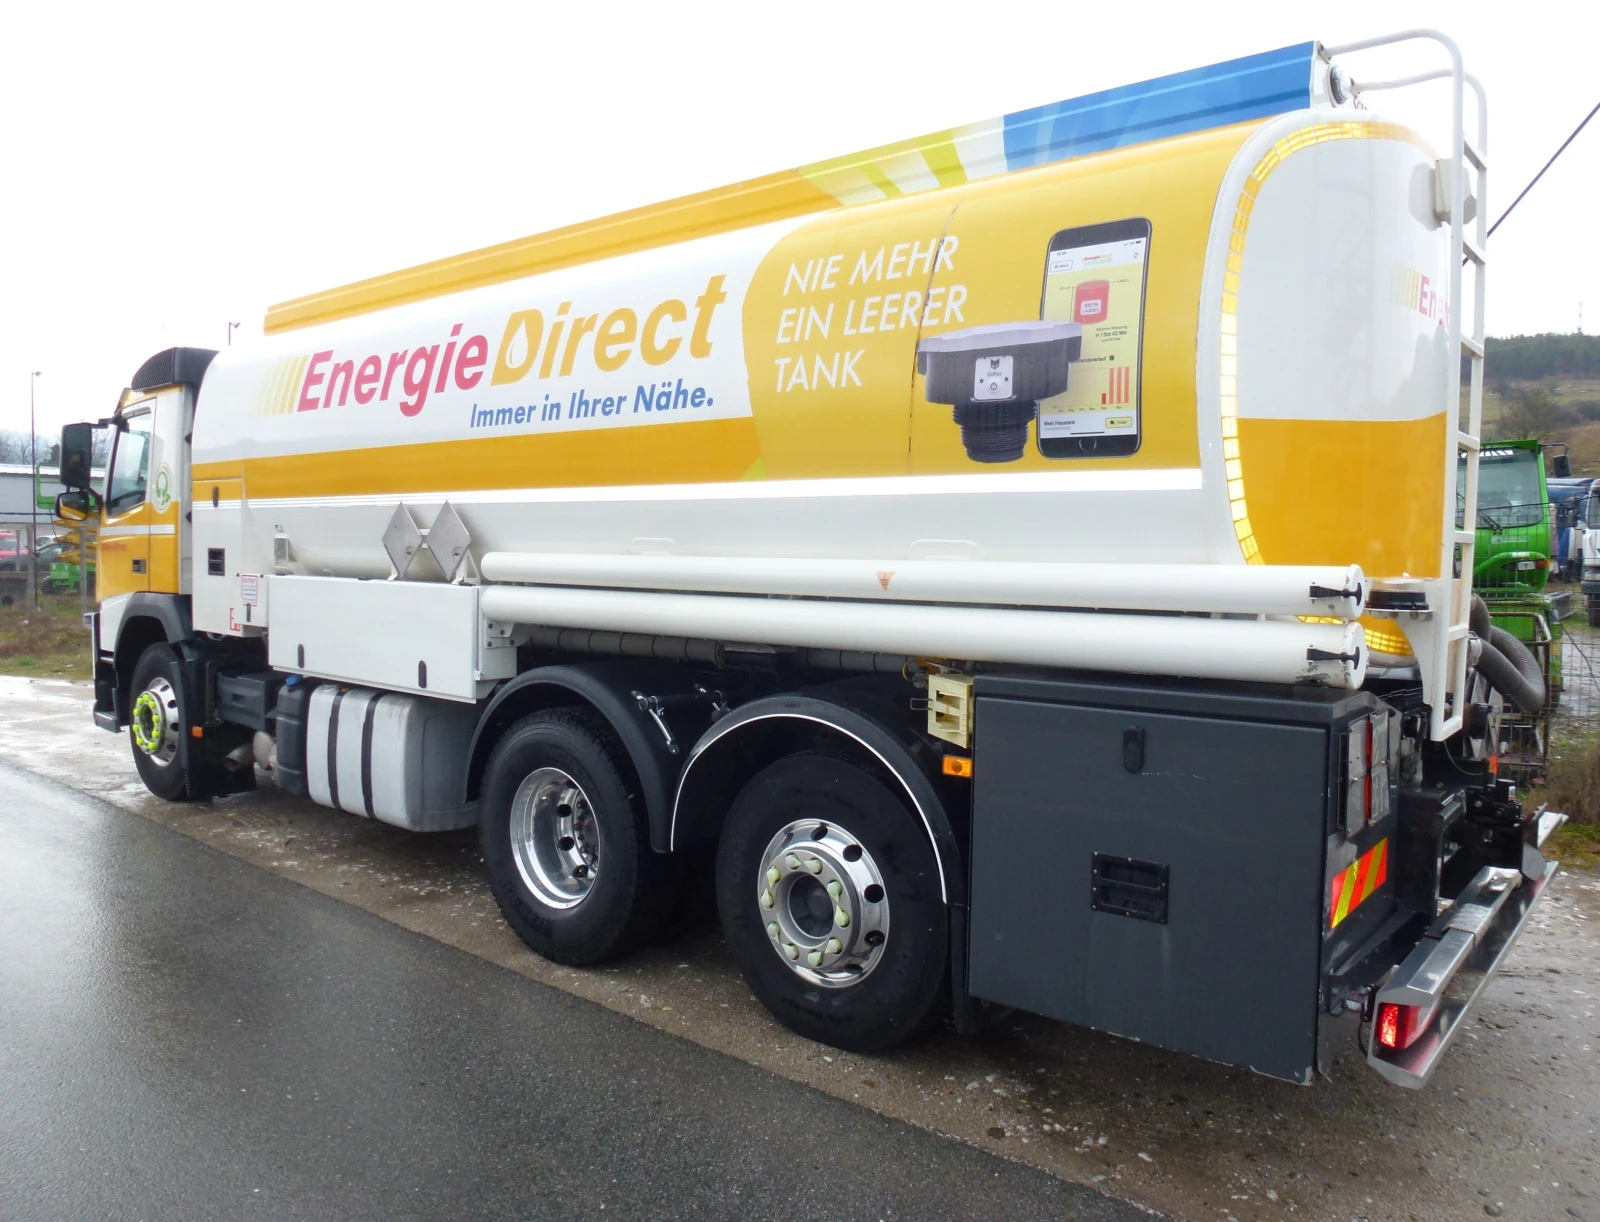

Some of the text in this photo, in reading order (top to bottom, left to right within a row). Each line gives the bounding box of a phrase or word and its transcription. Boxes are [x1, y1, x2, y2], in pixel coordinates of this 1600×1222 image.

[783, 235, 959, 296] NIE MEHR
[776, 284, 968, 344] EIN LEERER
[774, 349, 865, 393] TANK
[470, 378, 714, 428] Immer in Ihrer Nähe.
